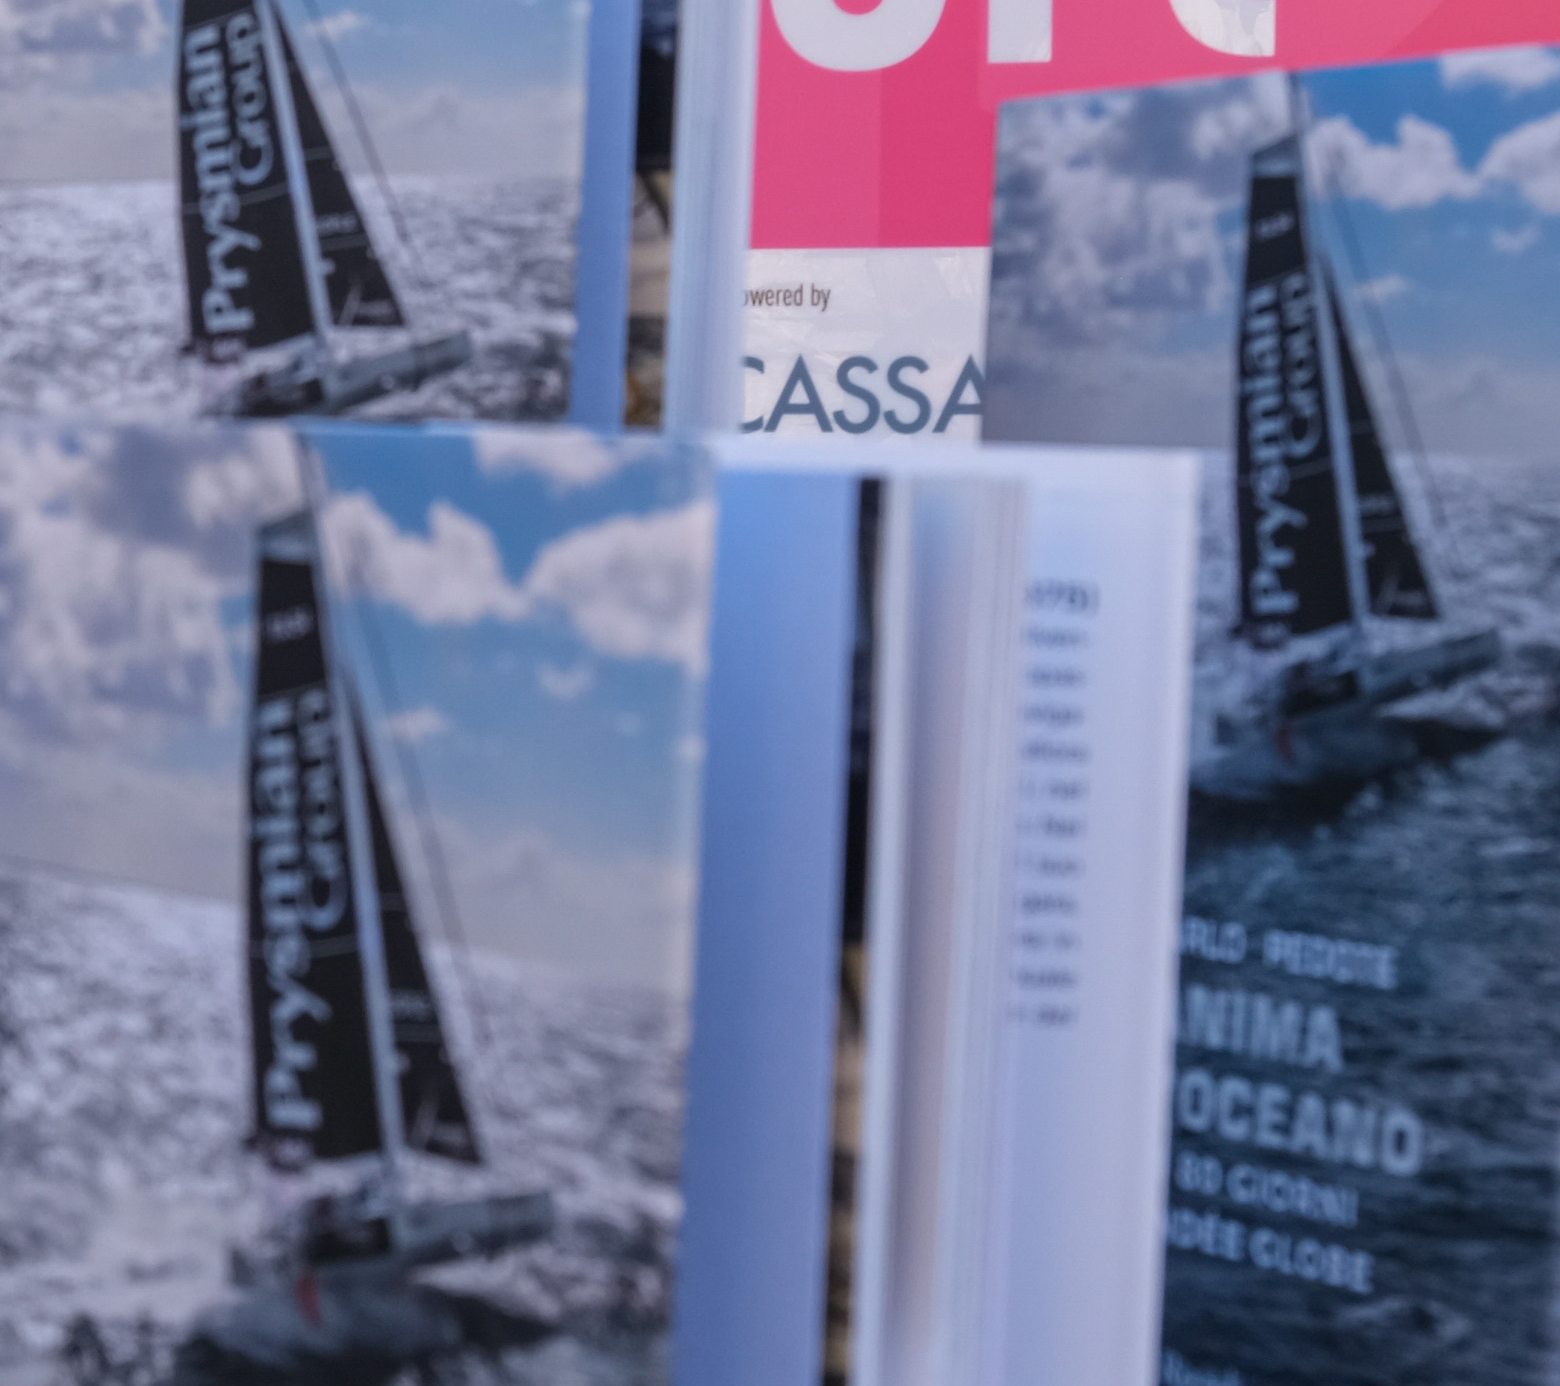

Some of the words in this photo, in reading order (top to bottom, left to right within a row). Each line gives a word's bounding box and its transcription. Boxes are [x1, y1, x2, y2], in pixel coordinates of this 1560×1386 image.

[182, 24, 261, 334] Prysmian
[227, 11, 274, 185] Group
[811, 282, 831, 313] by
[255, 699, 333, 1132] Prysmian
